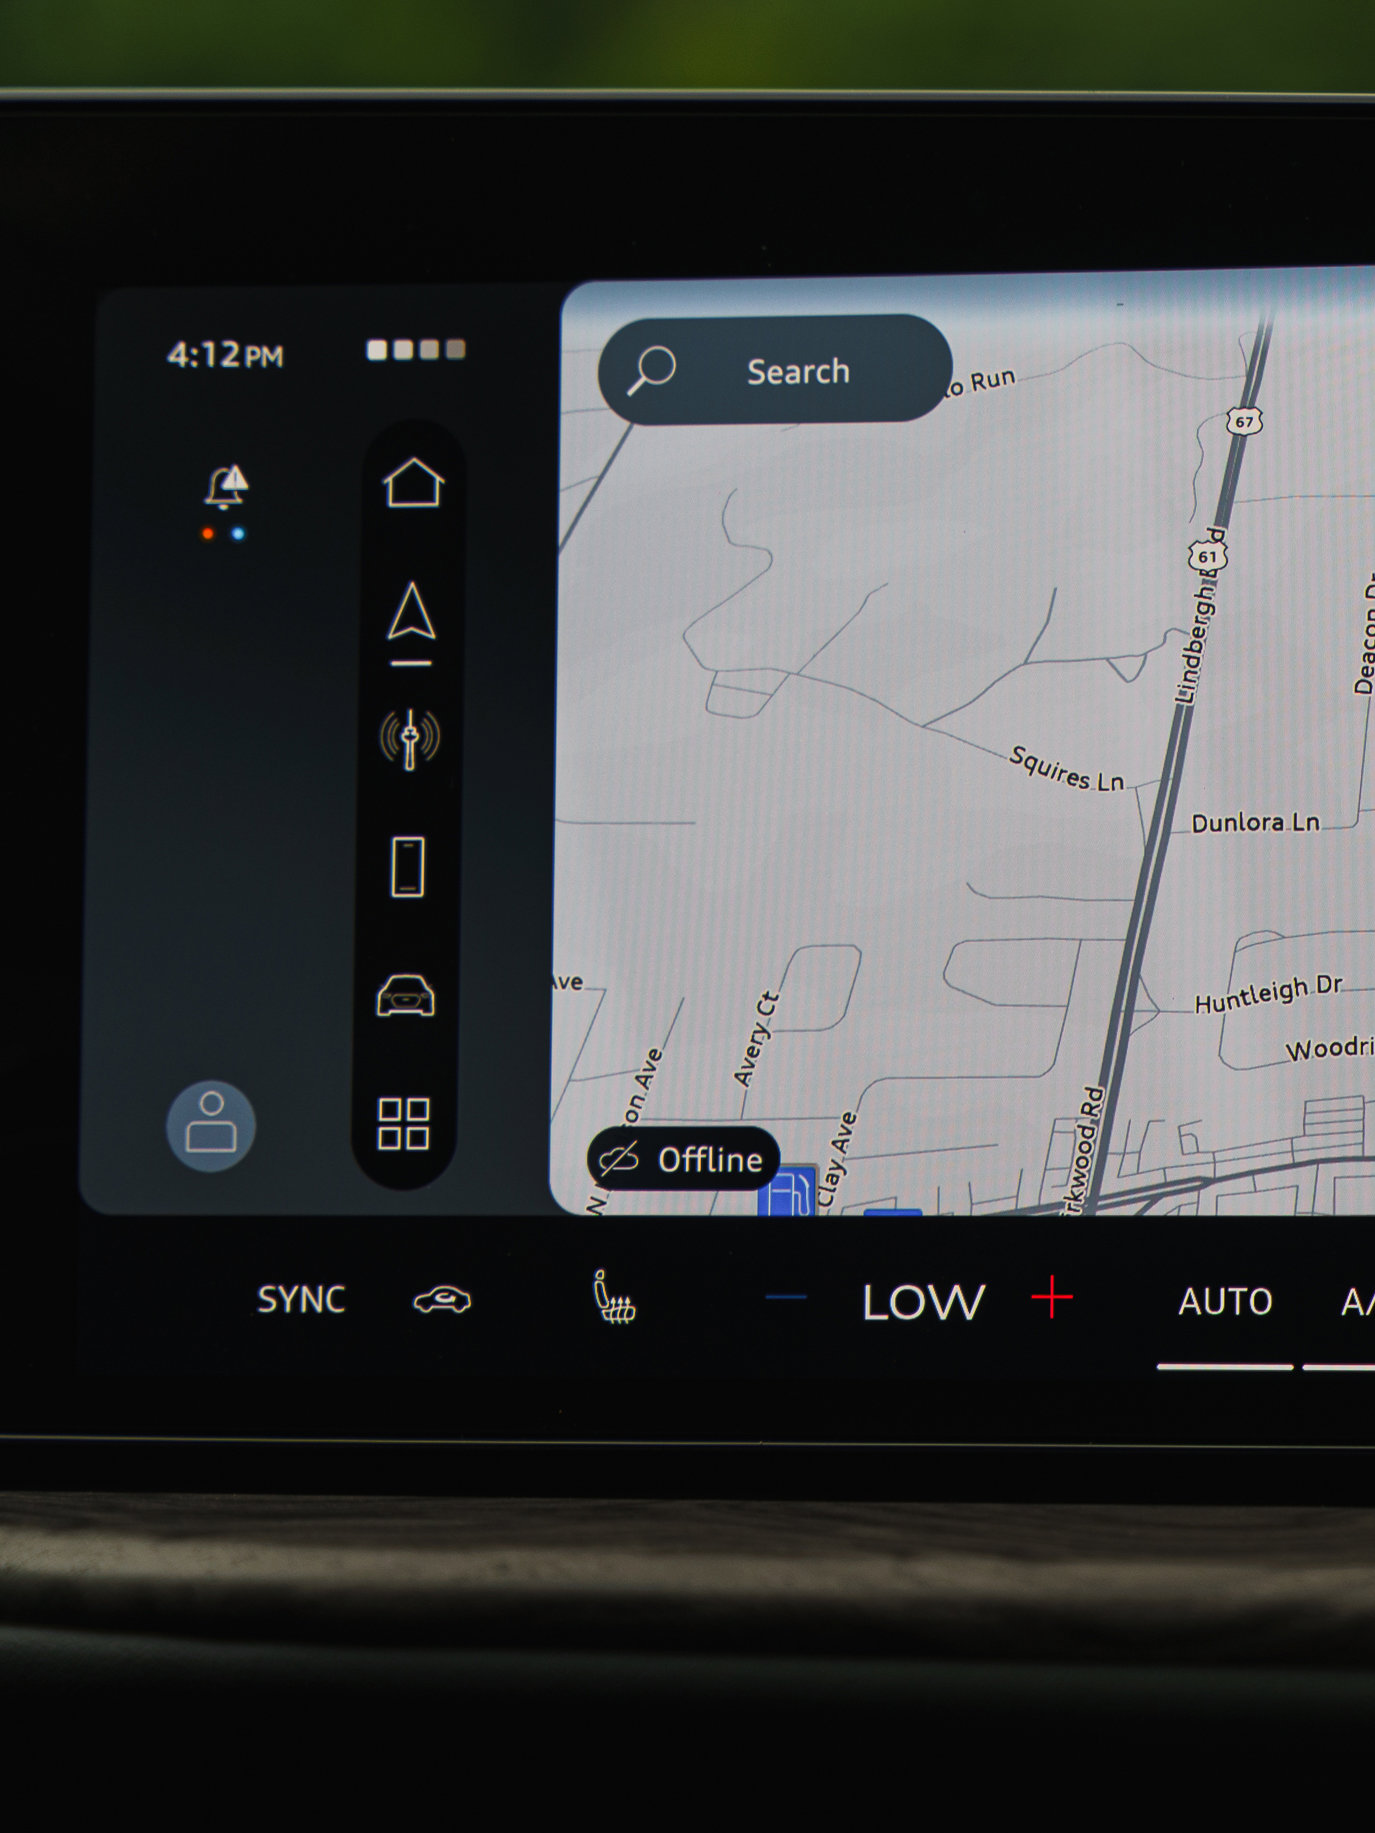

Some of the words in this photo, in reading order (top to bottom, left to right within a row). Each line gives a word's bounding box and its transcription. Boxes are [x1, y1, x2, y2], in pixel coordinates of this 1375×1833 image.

[748, 358, 849, 385] Search
[971, 370, 1015, 391] Run
[1235, 416, 1254, 430] 67
[1199, 551, 1216, 563] 61
[1175, 583, 1215, 703] Lindbergh
[1009, 745, 1090, 789] Squires
[1098, 772, 1124, 791] Ln
[1192, 813, 1284, 834] Dunlora
[1292, 813, 1320, 832] Ln
[1195, 977, 1308, 1014] Huntleigh
[1317, 975, 1343, 993] Dr
[733, 1022, 772, 1088] Avery
[757, 990, 779, 1016] Ct
[634, 1048, 663, 1091] Ave
[1081, 1086, 1103, 1118] Rd
[831, 1111, 857, 1154] Ave
[659, 1146, 763, 1173] Offline
[818, 1159, 847, 1207] Clay
[258, 1285, 346, 1313] SYNC
[864, 1284, 987, 1321] LOW
[1178, 1287, 1273, 1316] AUTO
